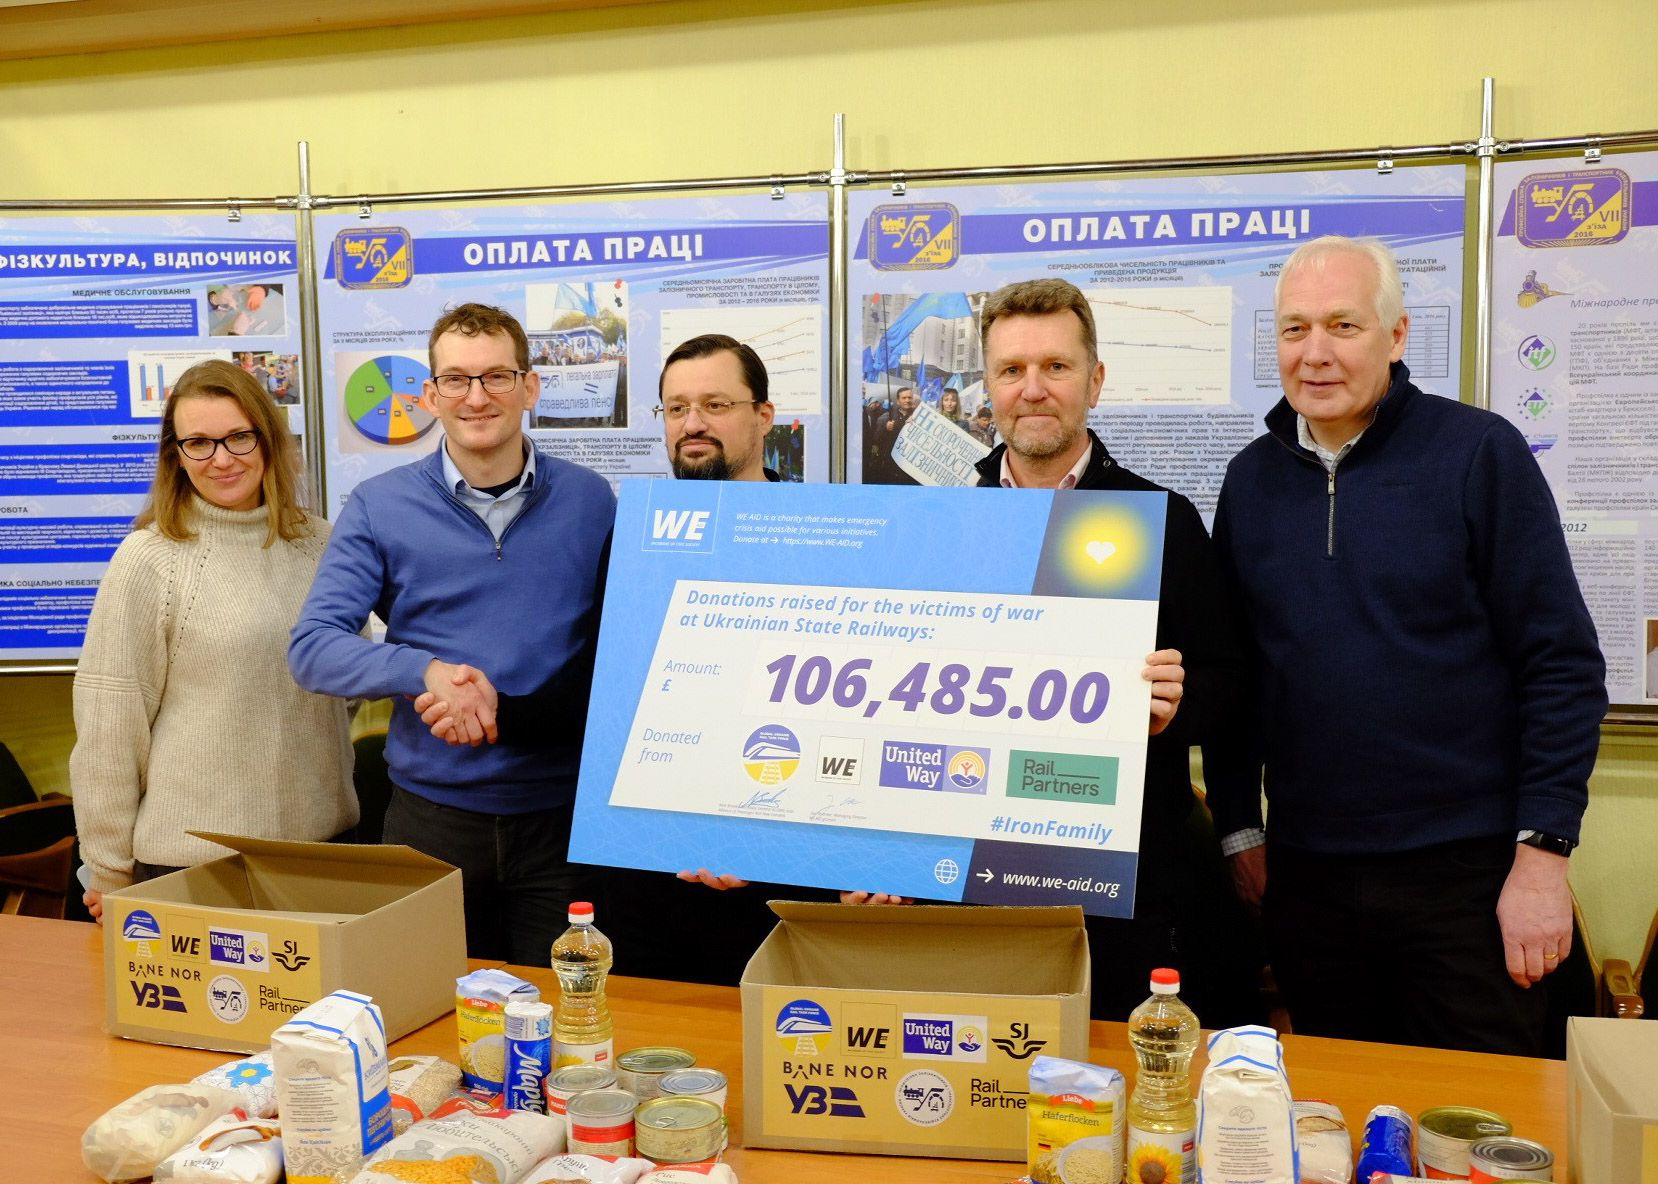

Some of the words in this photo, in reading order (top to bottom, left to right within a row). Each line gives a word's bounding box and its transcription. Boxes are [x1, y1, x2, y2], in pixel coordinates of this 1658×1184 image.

[1023, 213, 1177, 243] ОПЛАТА
[1191, 208, 1310, 239] ПРАЦІ
[463, 239, 592, 265] ОПЛАТА
[604, 233, 703, 261] ПРАЦІ
[154, 250, 292, 268] ВІДПОЧИНОК
[1120, 261, 1167, 269] ЧИСЕЛЬНІСТЬ
[72, 289, 112, 297] МЕДИЧНЕ
[114, 288, 191, 297] ОБСЛУГОВУВАННЯ
[1570, 297, 1639, 308] Міжнародне
[651, 509, 710, 541] WE
[777, 514, 803, 524] charity
[804, 515, 820, 523] that
[821, 516, 845, 524] makes
[847, 517, 888, 527] emergency
[734, 524, 753, 532] crisis
[767, 525, 797, 534] possible
[798, 526, 810, 535] for
[841, 527, 878, 536] initiatives.
[733, 535, 759, 543] Donate
[783, 537, 863, 548] https://www.WE-AID.org
[16, 579, 63, 588] СОЦІАЛЬНО
[686, 588, 774, 609] Donations
[780, 594, 837, 611] raised
[838, 596, 868, 616] for
[873, 597, 904, 615] the
[909, 600, 976, 618] victims
[982, 602, 1003, 624] of
[1007, 606, 1045, 621] war
[679, 613, 697, 627] at
[703, 612, 789, 632] Ukrainian
[794, 617, 841, 635] State
[847, 619, 935, 642] Railways:
[663, 659, 722, 676] Amount:
[661, 679, 672, 691] £
[766, 654, 1111, 724] 106,485.00
[642, 727, 702, 745] Donated
[637, 747, 673, 764] from
[885, 745, 942, 766] United
[821, 756, 858, 777] WE
[1023, 758, 1056, 777] Rail
[905, 765, 941, 789] Way
[1021, 775, 1100, 797] Partners
[990, 815, 1113, 846] #IronFamily
[1002, 871, 1121, 899] www.we-aid.org
[171, 934, 201, 956] WE
[210, 933, 243, 949] United
[284, 940, 297, 956] SJ
[223, 946, 243, 964] Way
[170, 967, 201, 982] NOR
[259, 985, 280, 999] Rail
[259, 999, 304, 1014] Partner
[847, 1026, 890, 1049] WE
[905, 1022, 950, 1037] United
[1010, 1022, 1029, 1040] SJ
[922, 1036, 950, 1053] Way
[845, 1065, 888, 1080] NOR
[971, 1078, 1001, 1094] Rail
[970, 1093, 1027, 1110] Partne
[1062, 1094, 1083, 1105] Liebe
[1042, 1110, 1100, 1127] Haferflocken
